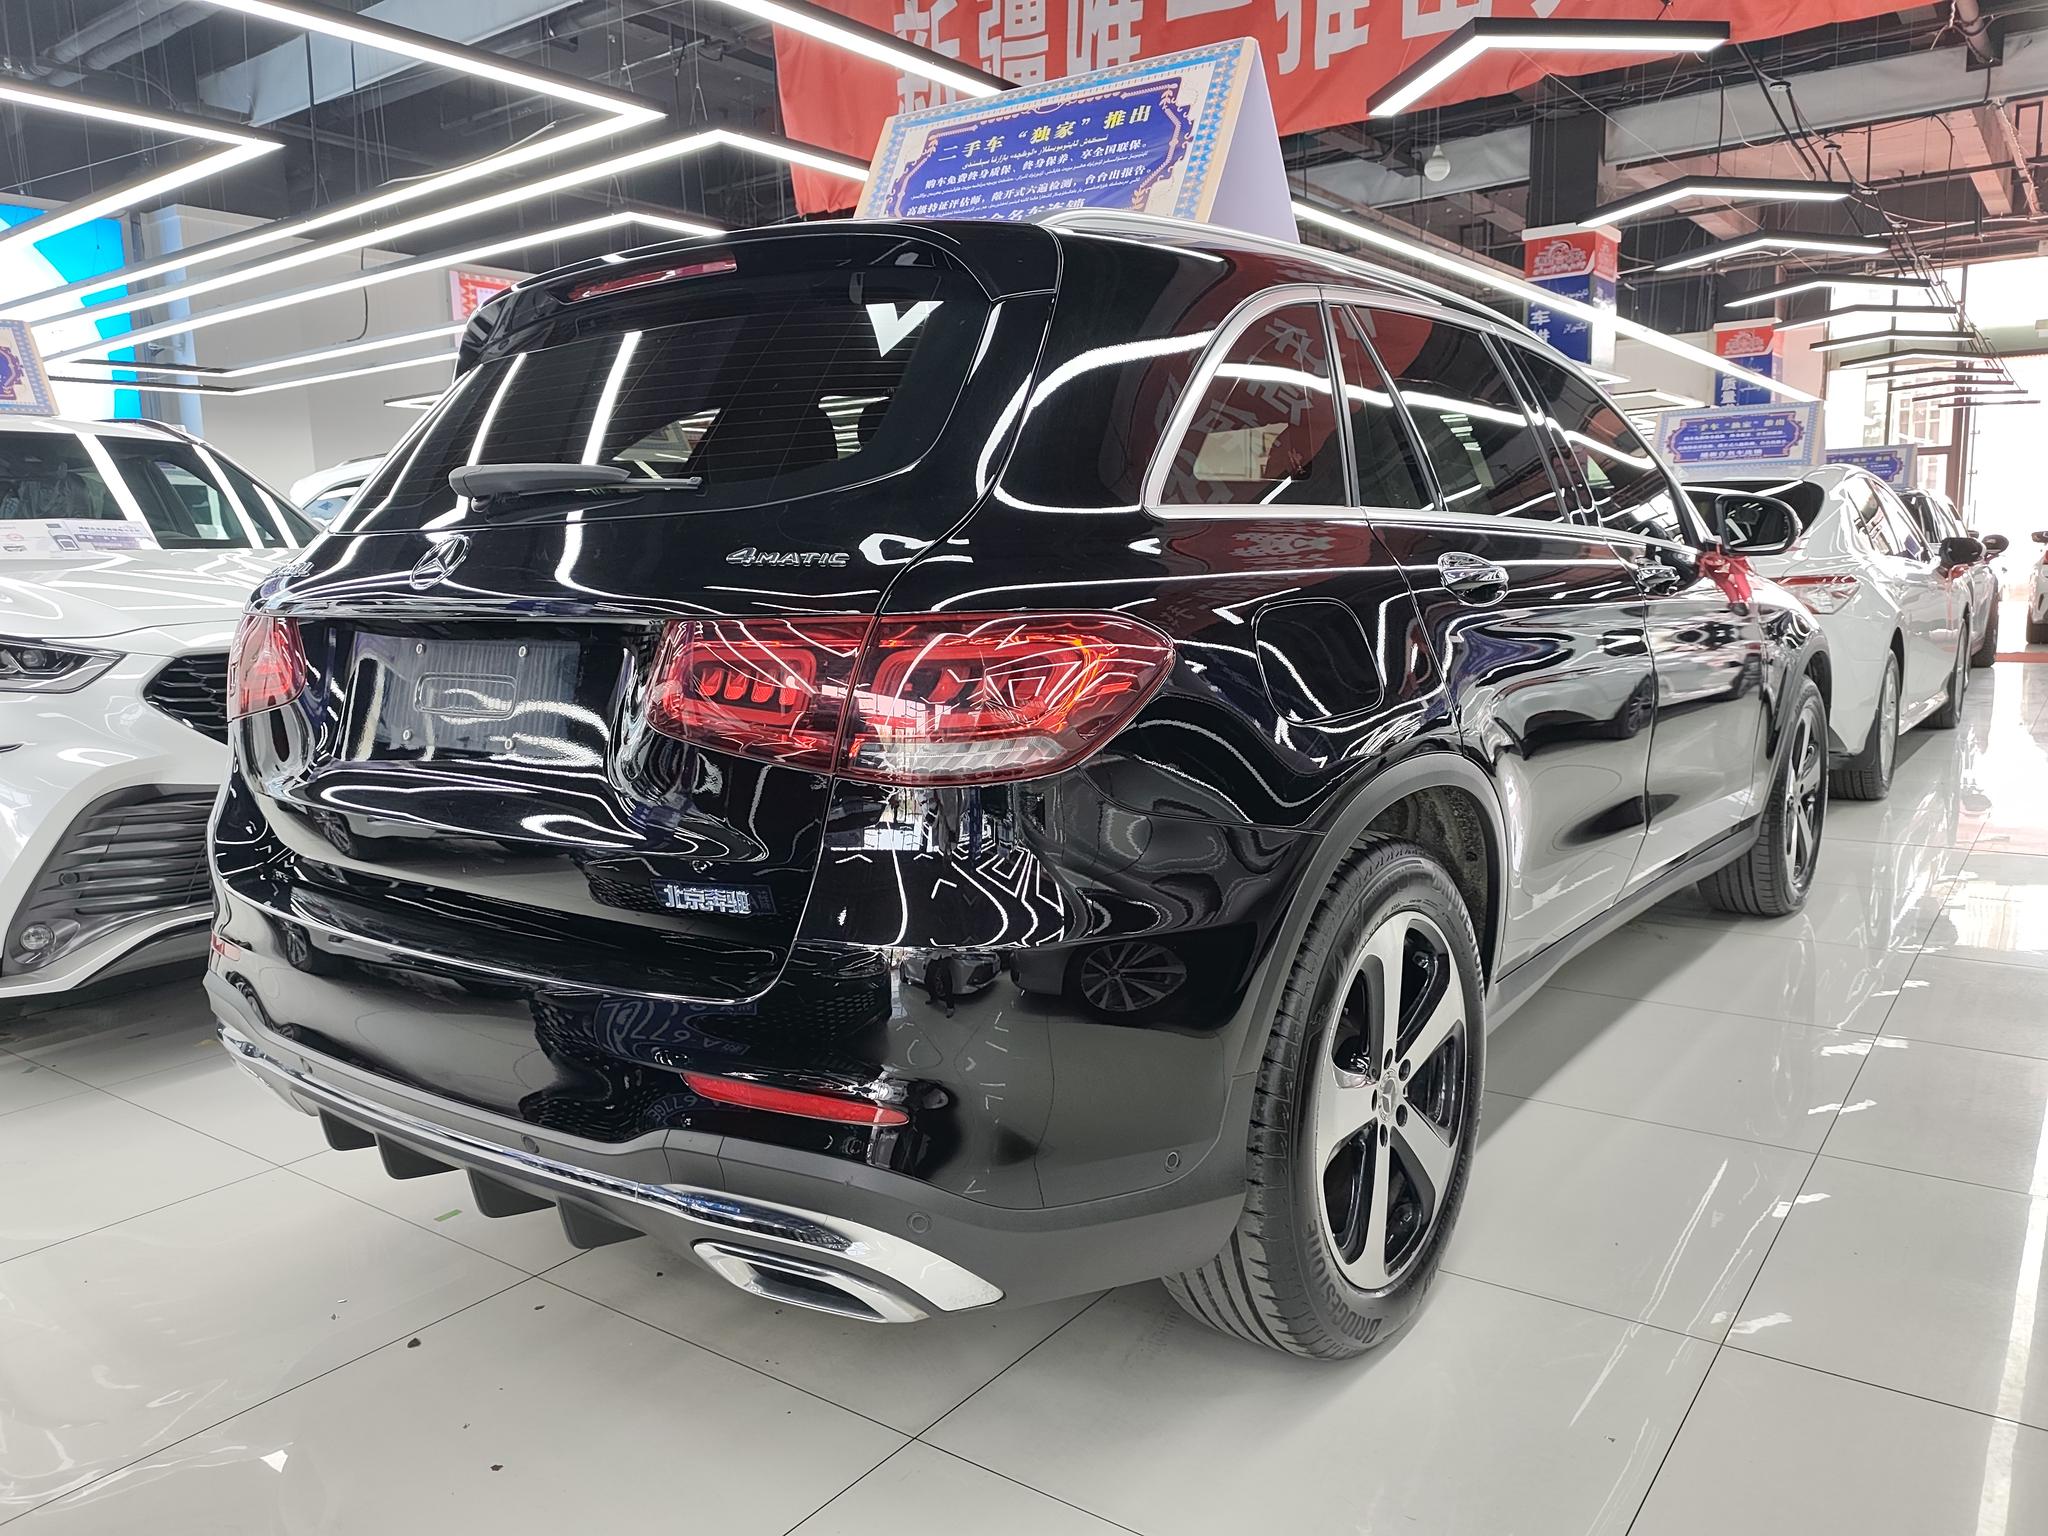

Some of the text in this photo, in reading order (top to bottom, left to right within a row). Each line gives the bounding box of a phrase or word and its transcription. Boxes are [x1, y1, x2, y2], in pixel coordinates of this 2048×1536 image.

[726, 547, 850, 568] 4MATIC
[664, 884, 751, 914] 北京奔驰
[1303, 1221, 1384, 1343] BRIDGESTONE
